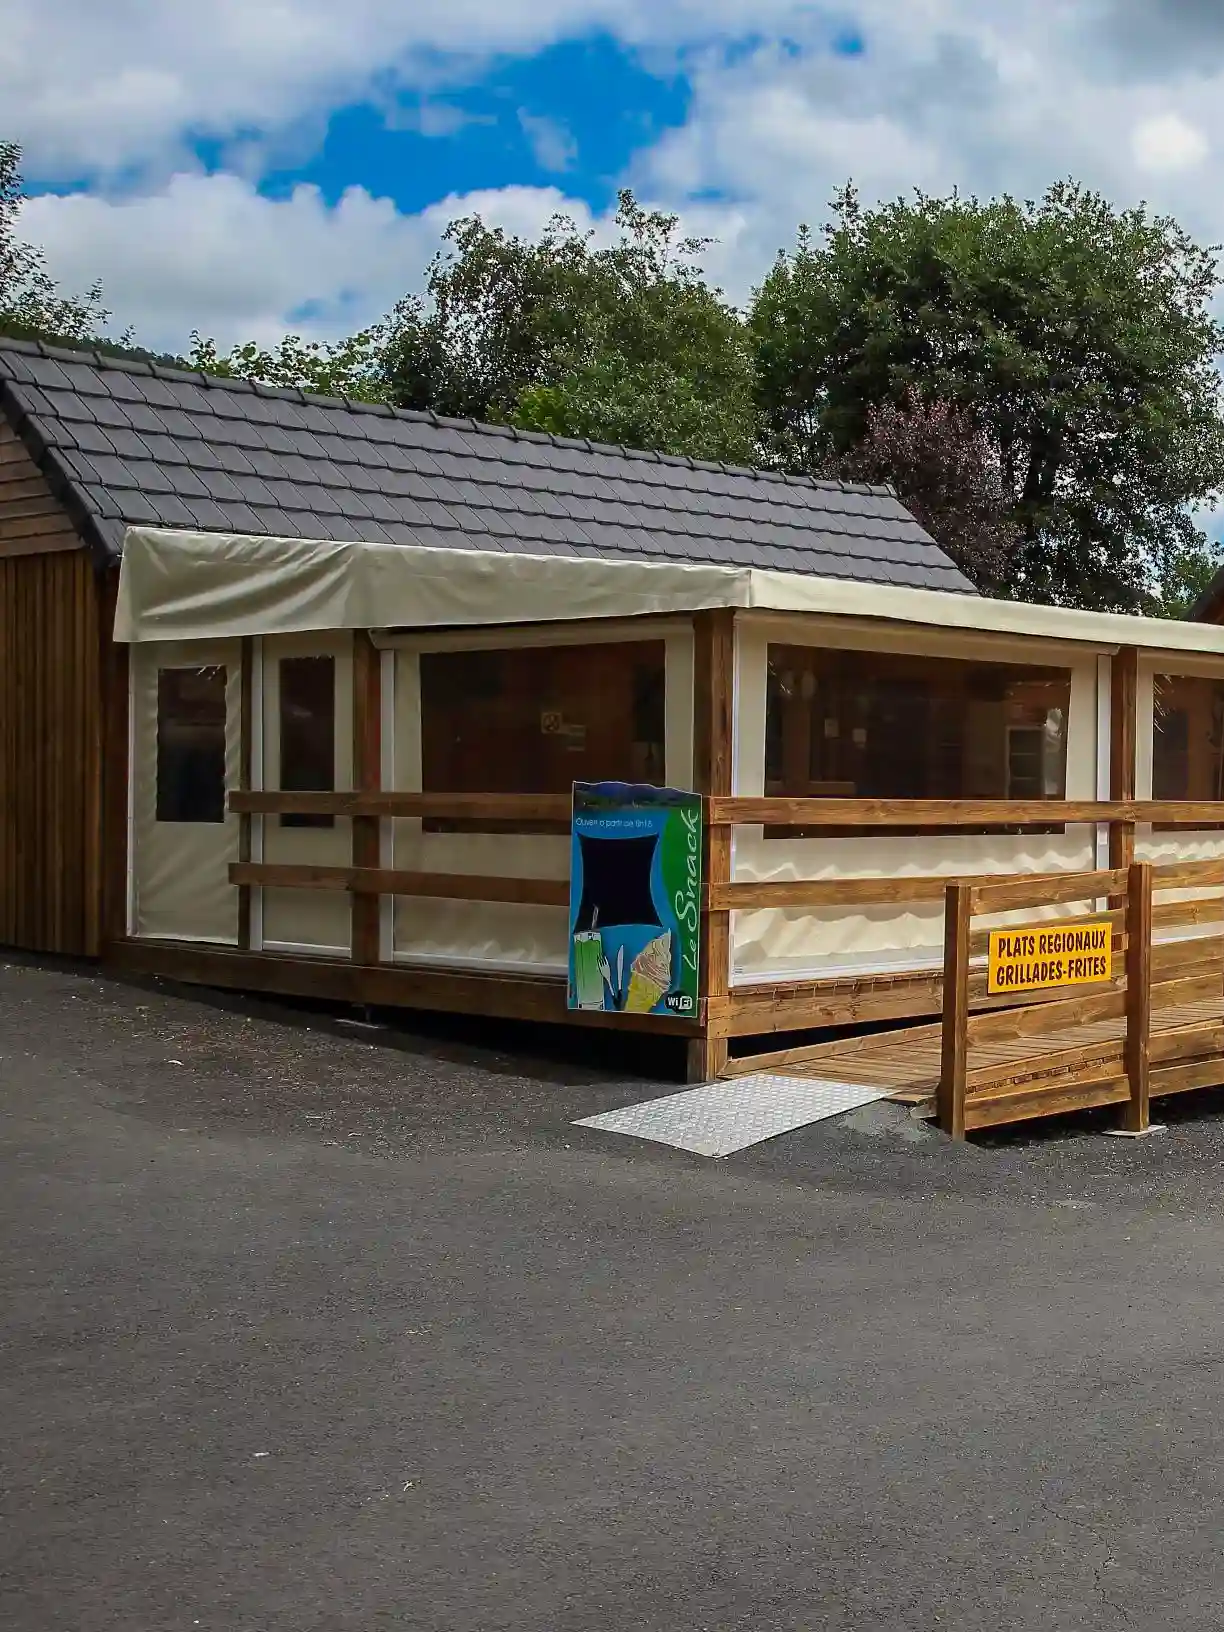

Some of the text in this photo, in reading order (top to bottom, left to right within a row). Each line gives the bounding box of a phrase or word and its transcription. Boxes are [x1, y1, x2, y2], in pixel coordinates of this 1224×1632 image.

[674, 808, 699, 971] Le Snack
[997, 929, 1106, 959] PLATS REGIONAUX
[996, 955, 1107, 986] GRILLADES-FRITES
